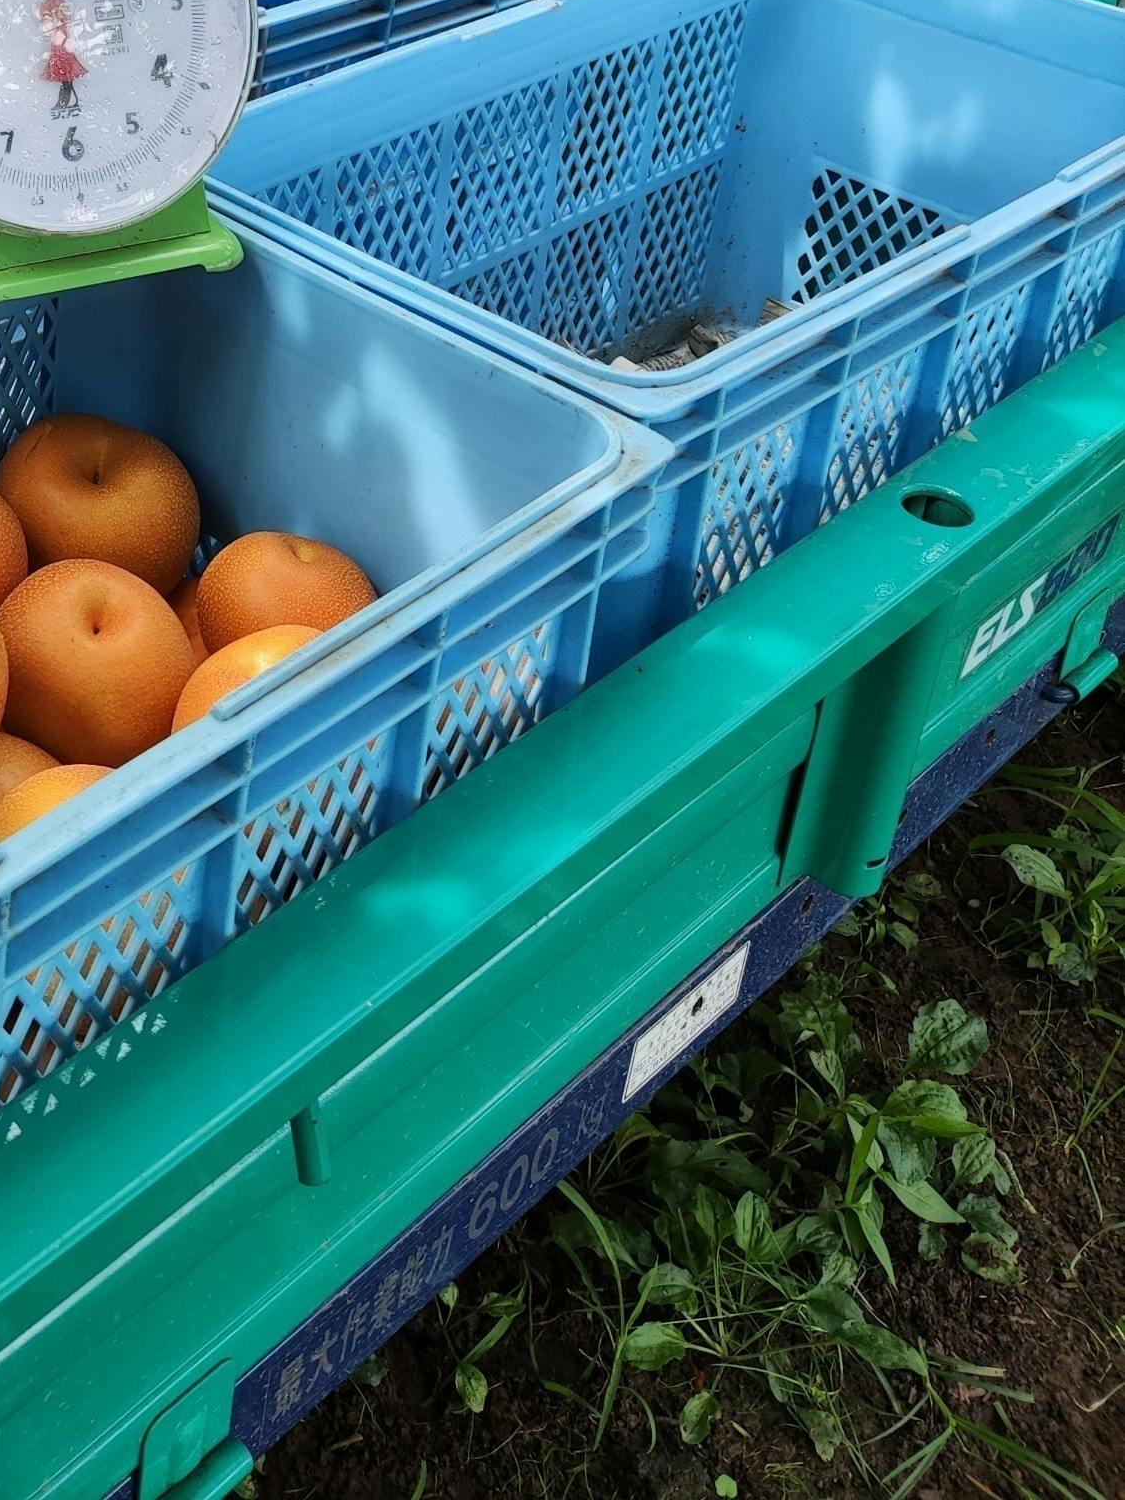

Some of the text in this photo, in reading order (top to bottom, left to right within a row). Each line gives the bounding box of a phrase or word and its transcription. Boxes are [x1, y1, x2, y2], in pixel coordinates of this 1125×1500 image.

[150, 53, 175, 88] 4
[125, 112, 140, 135] 5
[0, 130, 14, 154] 7
[61, 126, 85, 162] 6
[273, 1224, 458, 1422] 最大作業能力
[467, 1127, 560, 1241] 600
